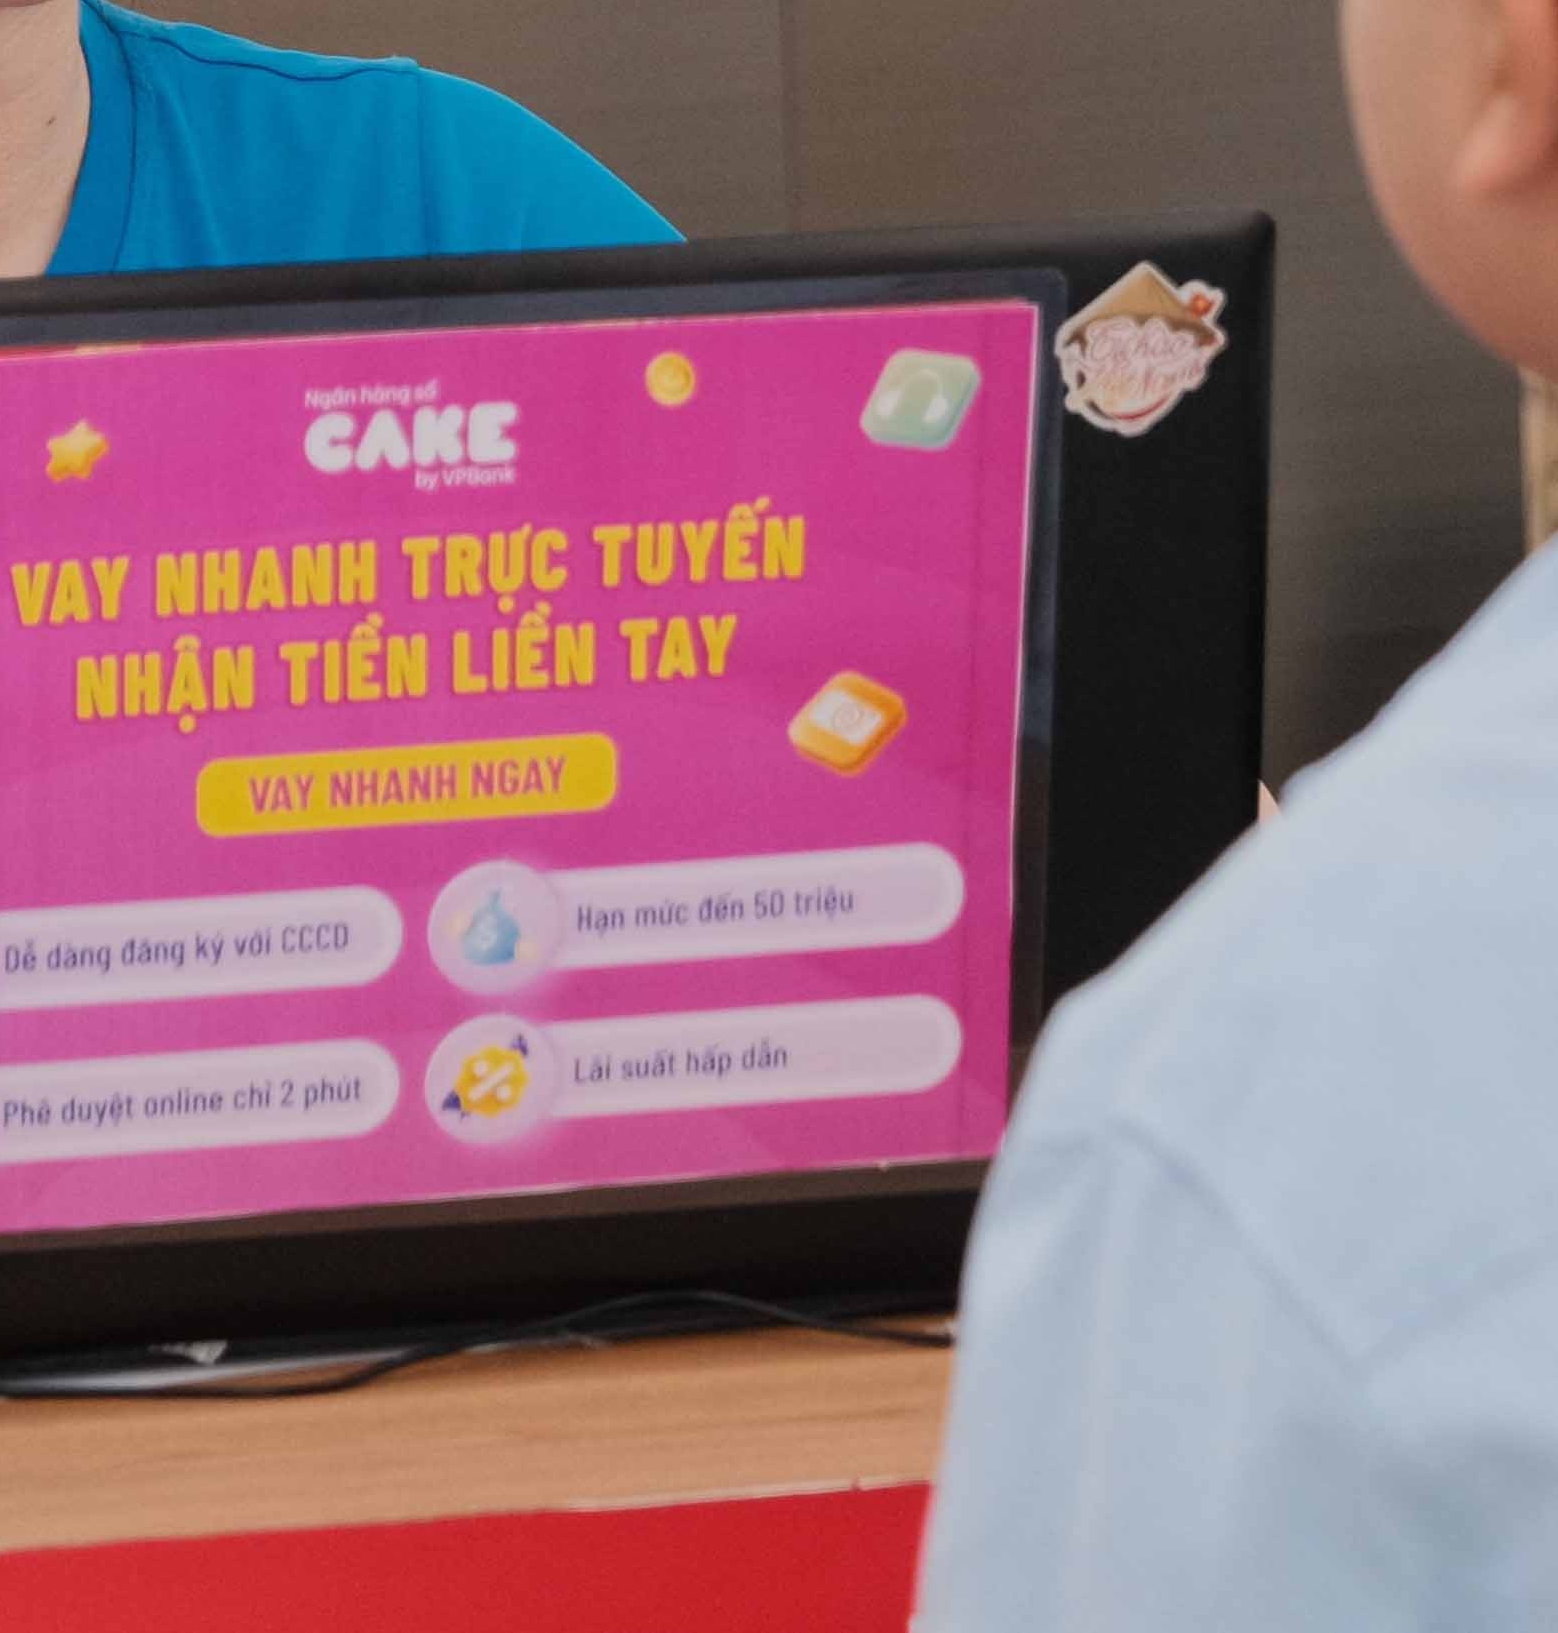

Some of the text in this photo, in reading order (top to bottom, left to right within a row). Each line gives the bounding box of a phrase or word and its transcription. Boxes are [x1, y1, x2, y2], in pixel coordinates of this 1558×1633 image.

[304, 401, 519, 474] CAKE
[415, 465, 516, 491] by VPBank
[10, 495, 806, 627] VAY NHANH TRỰC TUYẾN
[75, 600, 738, 734] NHẬN TIỀN LIỀN TAY
[248, 755, 567, 814] VAY NHANH NGAY
[576, 886, 855, 937] Hạn mức đến 50 triệu
[4, 922, 351, 974] Dễ dàng đăng ký với CCCD
[573, 1035, 788, 1084] Lãi suất hấp dẫn
[3, 1074, 362, 1129] Phê duyệt online chỉ 2 phút
